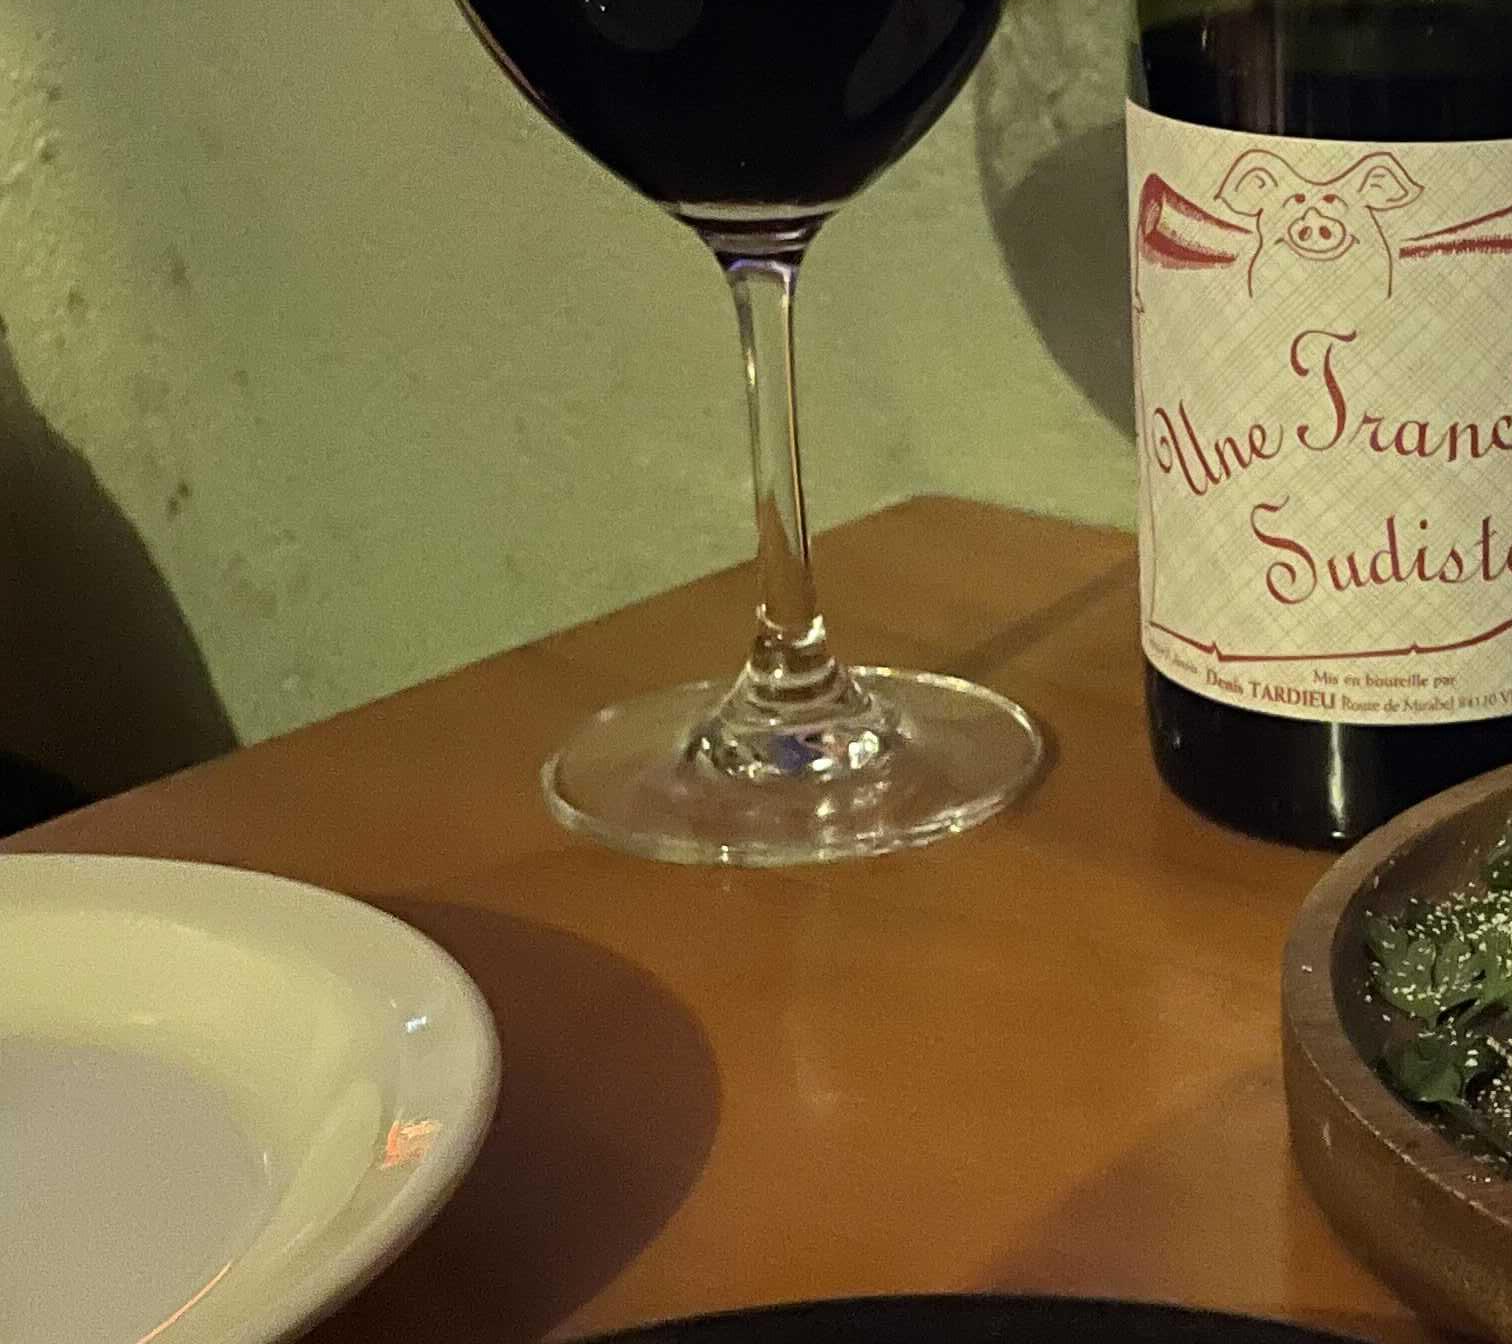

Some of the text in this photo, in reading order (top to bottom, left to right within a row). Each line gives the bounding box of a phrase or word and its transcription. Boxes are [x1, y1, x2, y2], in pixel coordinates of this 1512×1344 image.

[1152, 398, 1283, 496] Une
[1312, 669, 1338, 685] Mis
[1344, 674, 1360, 687] en
[1433, 675, 1456, 689] par
[1249, 681, 1336, 710] TARDIEU
[1384, 699, 1400, 713] de
